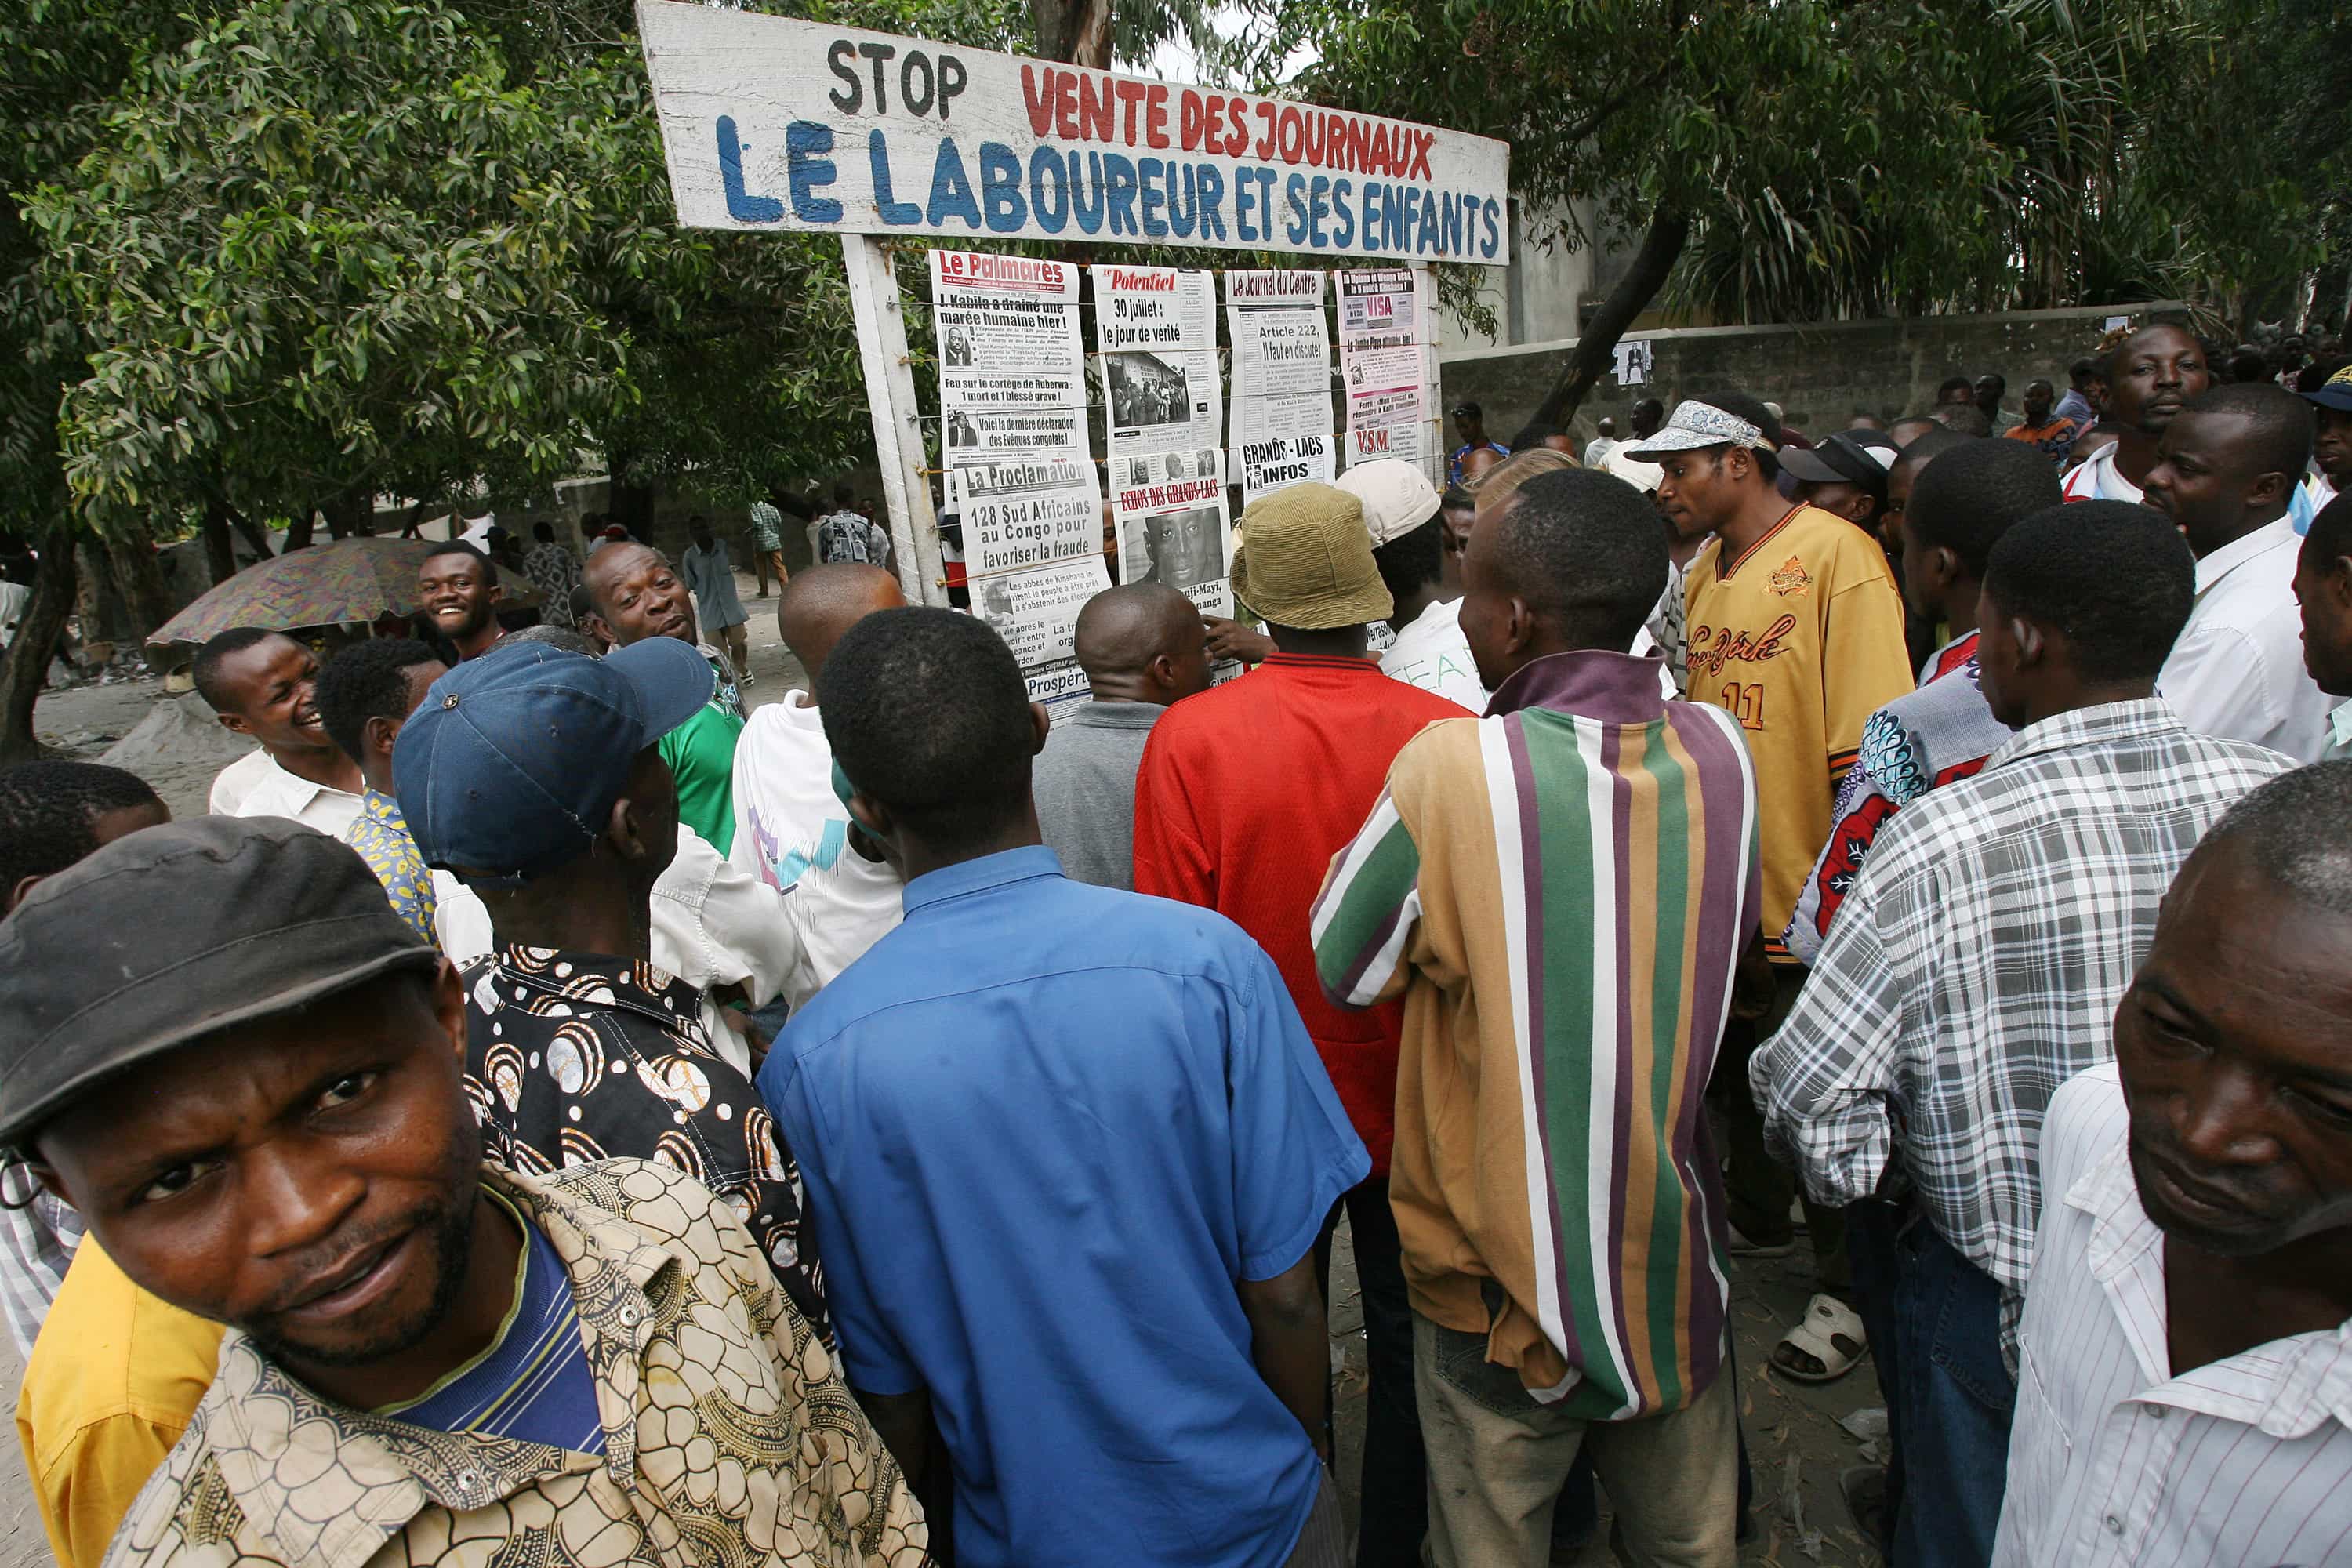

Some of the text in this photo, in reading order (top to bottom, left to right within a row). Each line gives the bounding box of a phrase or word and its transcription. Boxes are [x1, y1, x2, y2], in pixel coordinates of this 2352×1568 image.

[827, 39, 967, 120] STOP
[1021, 64, 1436, 181] VENTE DES JOURNAUX
[716, 114, 1500, 259] LE LABOUREUR ET SES ENFANTS
[938, 251, 963, 275] Le
[1111, 269, 1176, 293] Potentiel
[1232, 270, 1243, 296] Le
[1246, 270, 1276, 296] Journal
[1277, 270, 1287, 296] du
[1289, 271, 1317, 295] Centre
[950, 294, 990, 310] Kabila
[993, 300, 1000, 310] a
[1002, 297, 1040, 313] drainé
[1043, 303, 1064, 314] une
[1114, 298, 1127, 318] 30
[1129, 298, 1158, 322] juillet
[1367, 296, 1392, 316] VISA
[941, 311, 1067, 328] marée humaine hier !
[1102, 322, 1181, 348] le jour de vérité
[1259, 325, 1320, 338] Article 222,
[1269, 341, 1283, 361] faut
[1285, 345, 1294, 360] en
[1294, 339, 1322, 358] discuter
[945, 379, 961, 389] Feu
[963, 380, 977, 389] sur
[979, 379, 987, 389] le
[989, 379, 1022, 391] cortège
[1023, 379, 1033, 389] de
[1036, 379, 1069, 390] Ruberwa
[962, 392, 966, 401] 1
[967, 392, 989, 401] mort
[991, 392, 1000, 401] et
[1001, 392, 1005, 401] 1
[1007, 391, 1033, 401] blessé
[1035, 393, 1056, 402] grave
[979, 417, 1074, 431] Voici la dernière déclaration
[989, 434, 1003, 447] des
[1004, 434, 1031, 447] Evêques
[1032, 434, 1065, 447] congolais
[1243, 437, 1287, 465] GRANDS
[1295, 436, 1323, 458] LACS
[965, 467, 985, 489] La
[989, 462, 1085, 488] Proclamation
[1262, 463, 1308, 484] INFOS
[1120, 490, 1149, 512] ECHOS
[1149, 488, 1166, 509] DES
[971, 506, 997, 528] 128
[1003, 503, 1028, 524] Sud
[1033, 497, 1091, 521] Africains
[982, 518, 1087, 543] au Congo pour
[983, 537, 1089, 568] favoriser la fraude
[1009, 581, 1022, 591] Les
[1045, 576, 1054, 585] de
[1033, 590, 1039, 599] le
[1040, 586, 1063, 597] peuple
[1070, 581, 1083, 591] être
[1085, 579, 1099, 590] prêt
[1184, 581, 1222, 600] uji-Mayi,
[1022, 598, 1055, 612] s'abstenir
[1196, 597, 1221, 609] nanga
[1003, 620, 1045, 636] vie après le
[1027, 632, 1046, 642] entre
[1053, 626, 1065, 635] La
[1014, 642, 1045, 655] eance et
[1058, 637, 1073, 647] org
[1710, 613, 1797, 677] York
[1018, 656, 1034, 666] rdon
[1722, 682, 1763, 731] 11
